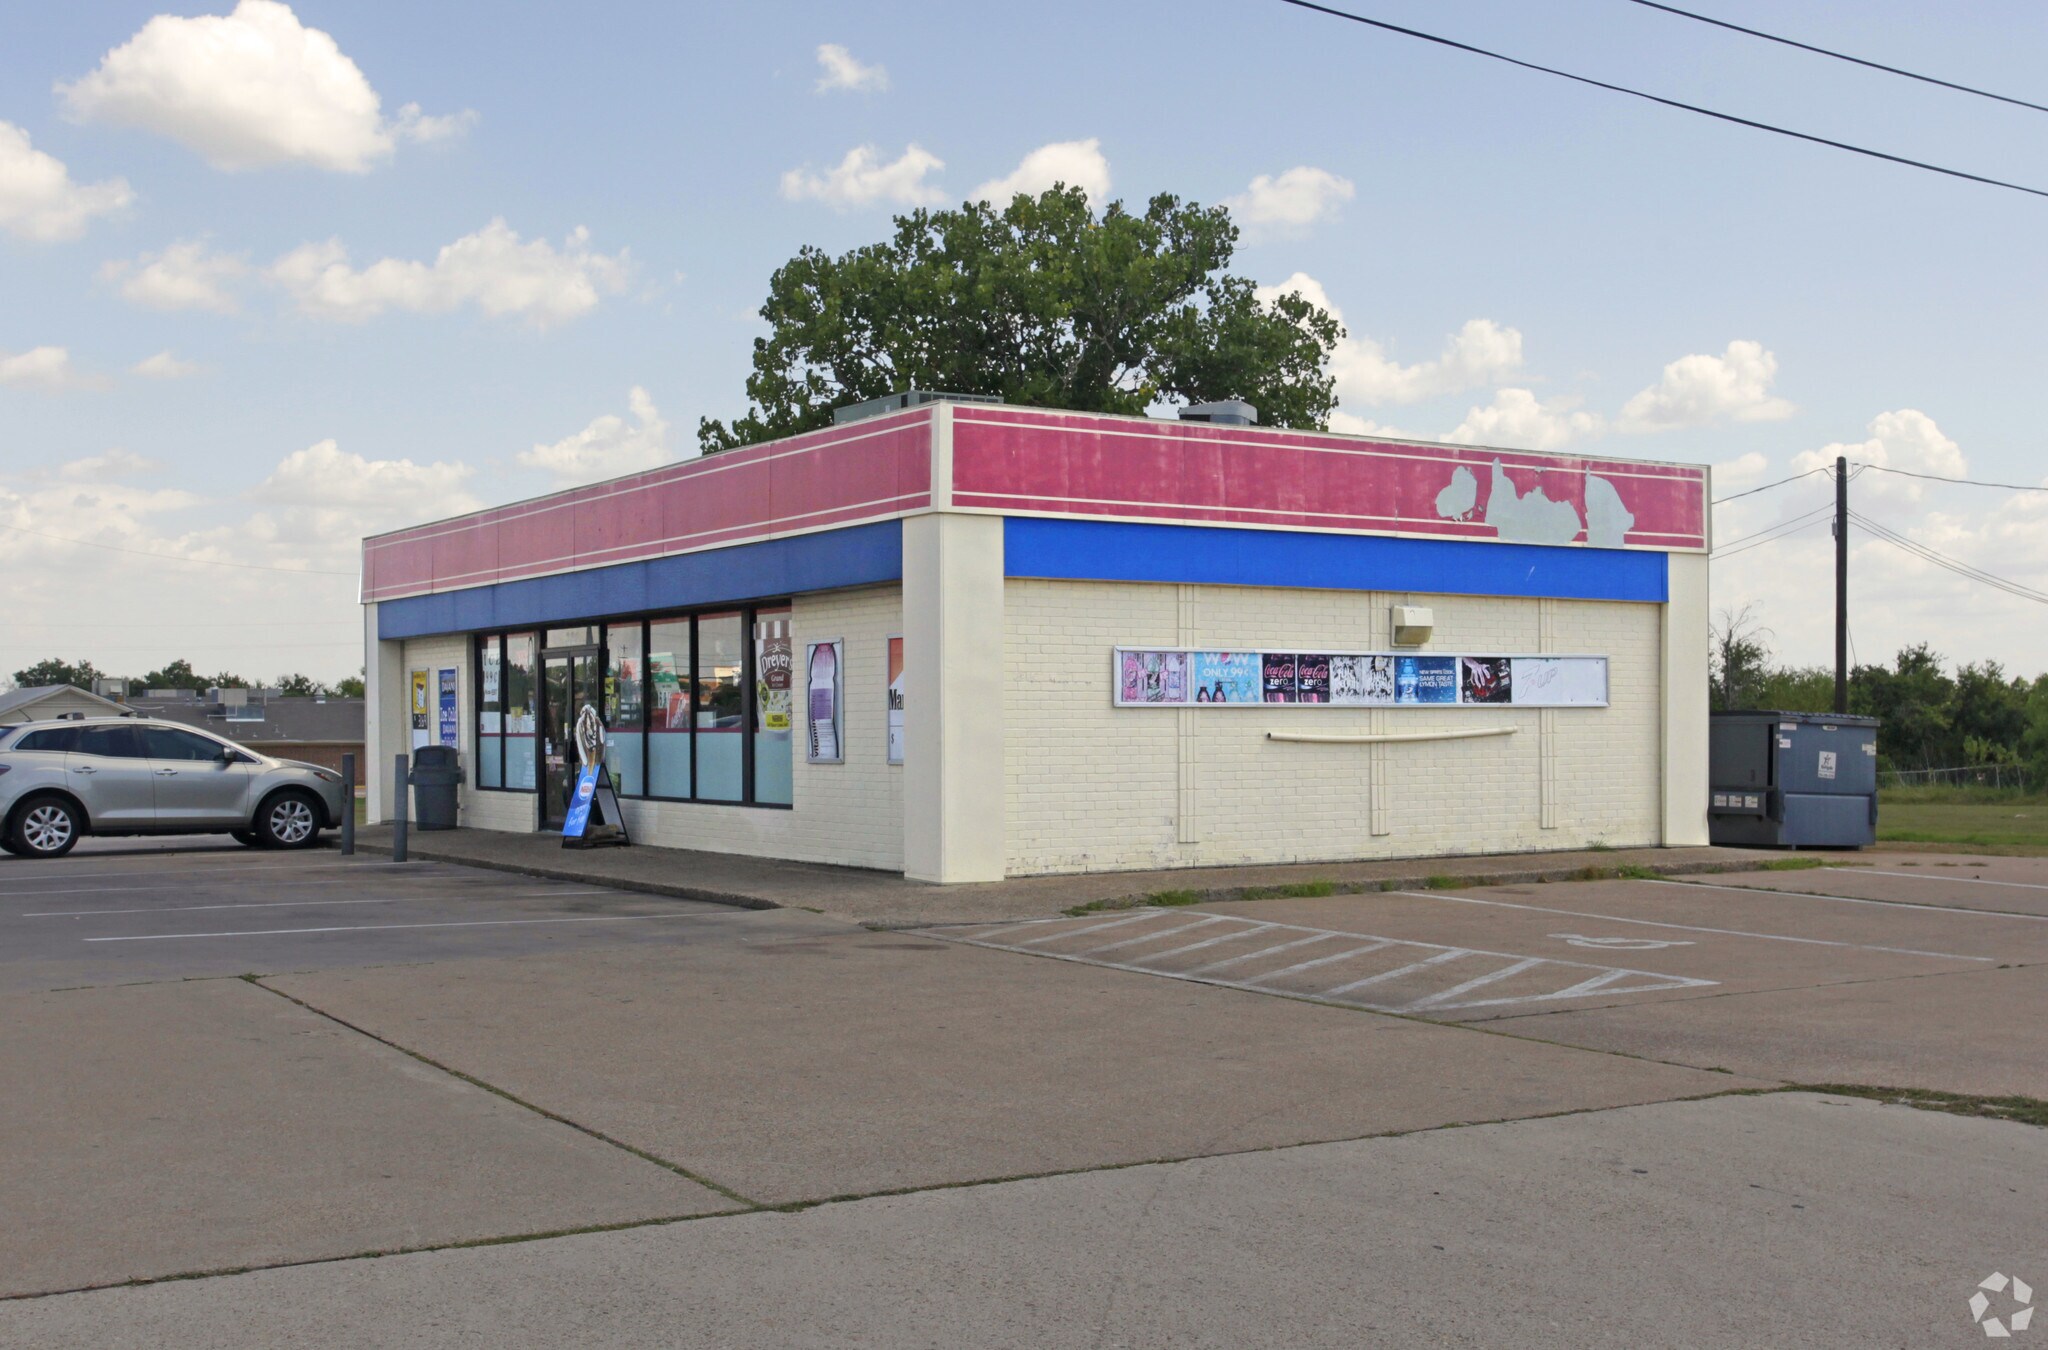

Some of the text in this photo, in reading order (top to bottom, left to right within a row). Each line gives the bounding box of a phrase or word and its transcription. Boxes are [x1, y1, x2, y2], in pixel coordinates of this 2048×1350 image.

[1203, 667, 1228, 677] ONLY
[1270, 678, 1288, 686] zero
[1304, 678, 1322, 686] zero
